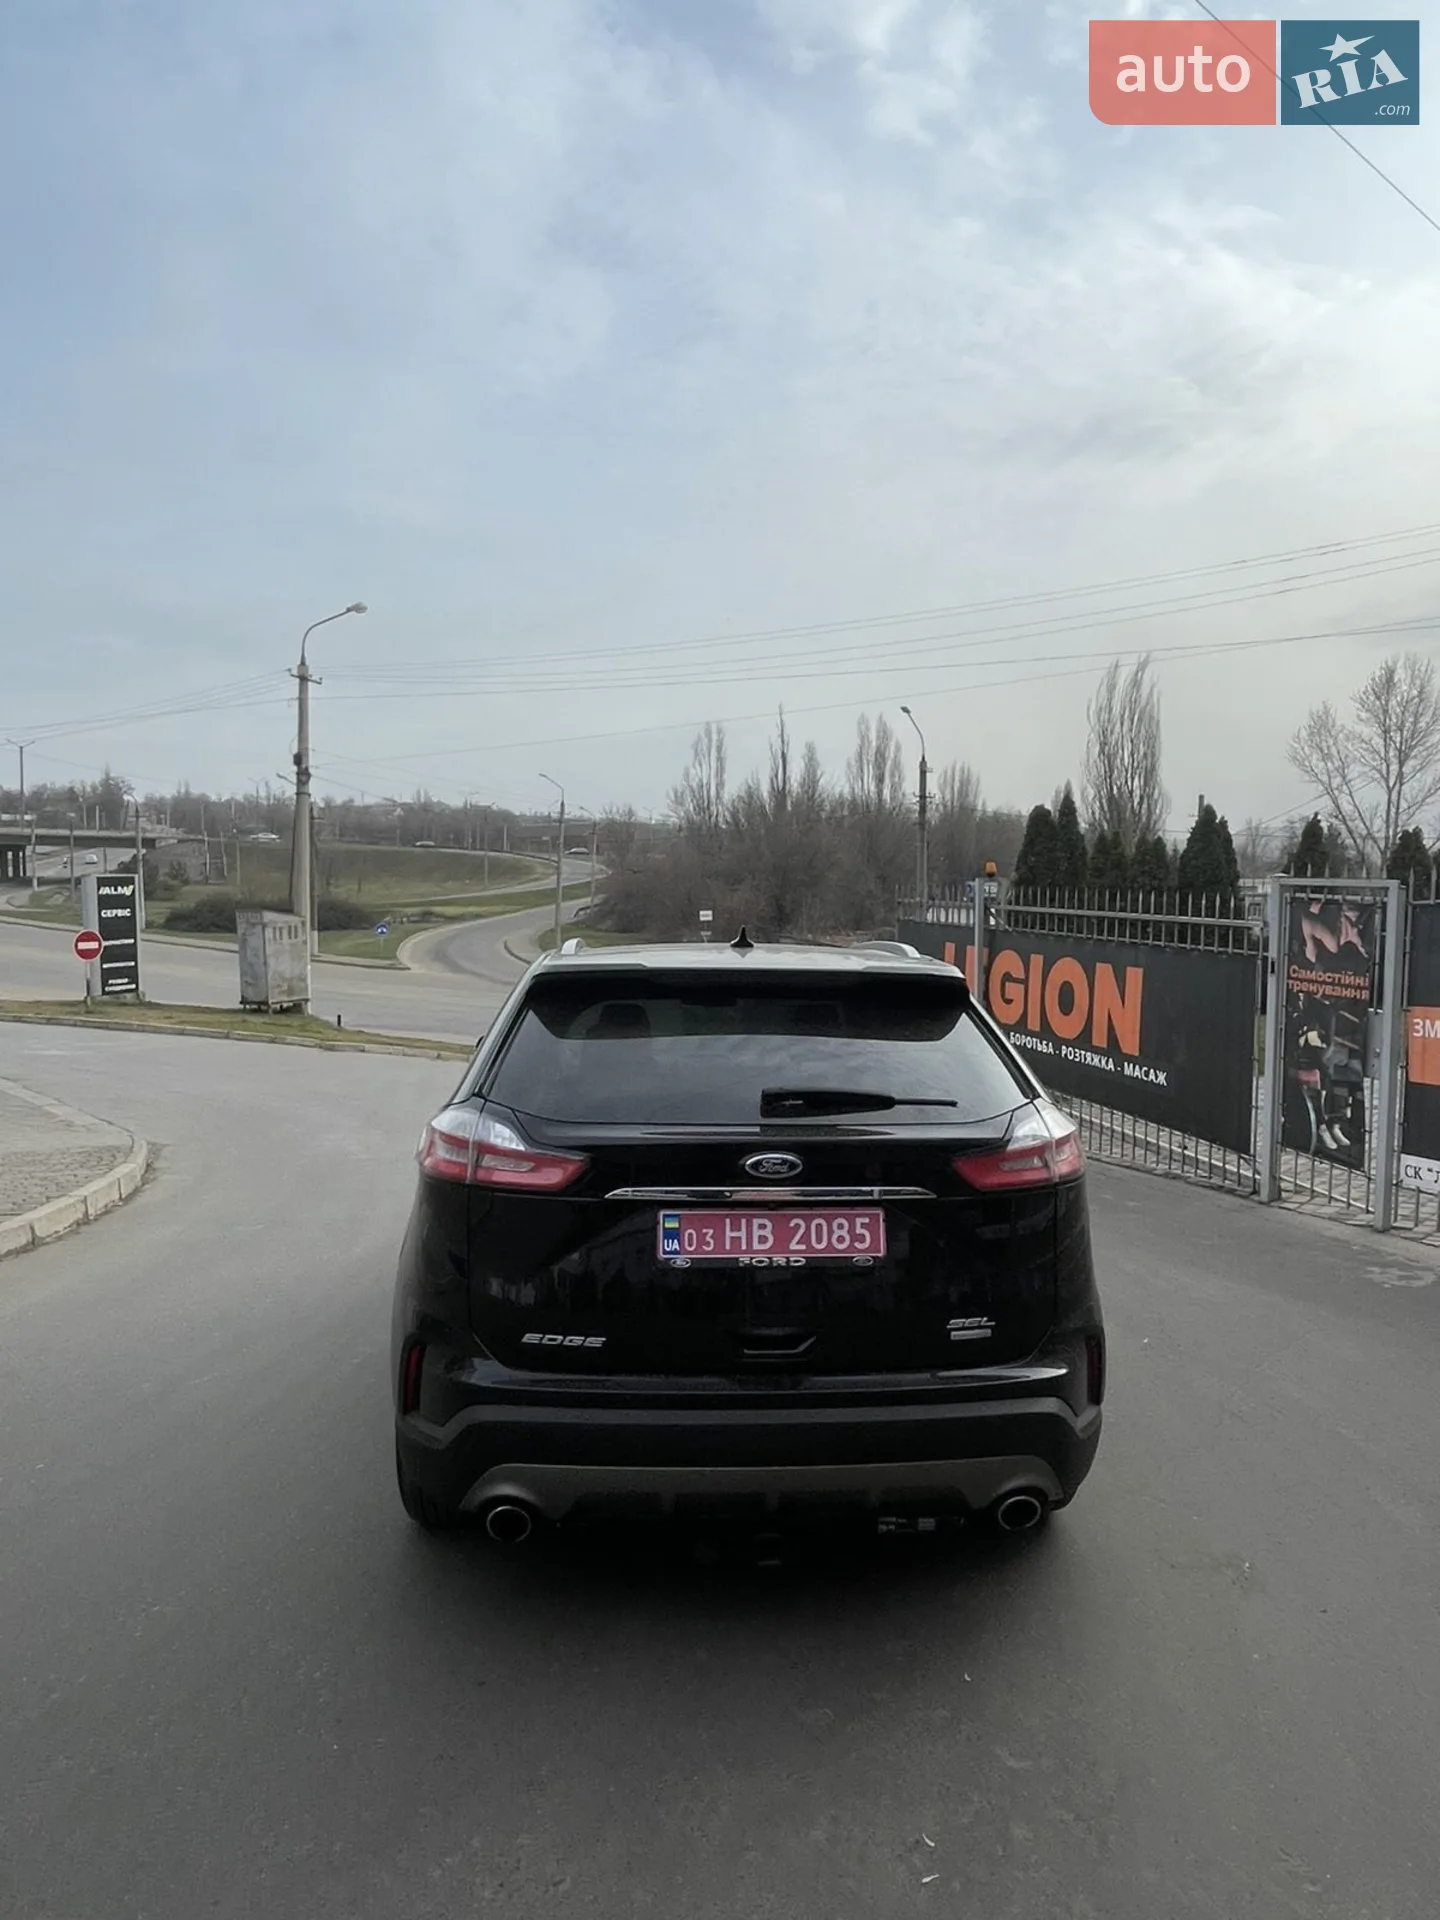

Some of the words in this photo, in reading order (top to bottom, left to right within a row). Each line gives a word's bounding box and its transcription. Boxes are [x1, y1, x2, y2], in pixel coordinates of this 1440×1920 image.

[1289, 964, 1370, 987] Самостійні
[1287, 979, 1370, 1002] тренування
[1010, 1031, 1055, 1056] БОРОТЬБА
[1061, 1044, 1115, 1072] РОЗТЯЖКА
[1123, 1061, 1168, 1087] МАСАЖ
[1404, 1163, 1423, 1182] СК
[664, 1238, 680, 1252] UA
[684, 1229, 715, 1251] 03
[724, 1217, 774, 1251] HB
[788, 1217, 872, 1251] 2085
[738, 1256, 806, 1267] FORD
[521, 1332, 607, 1347] EDGE
